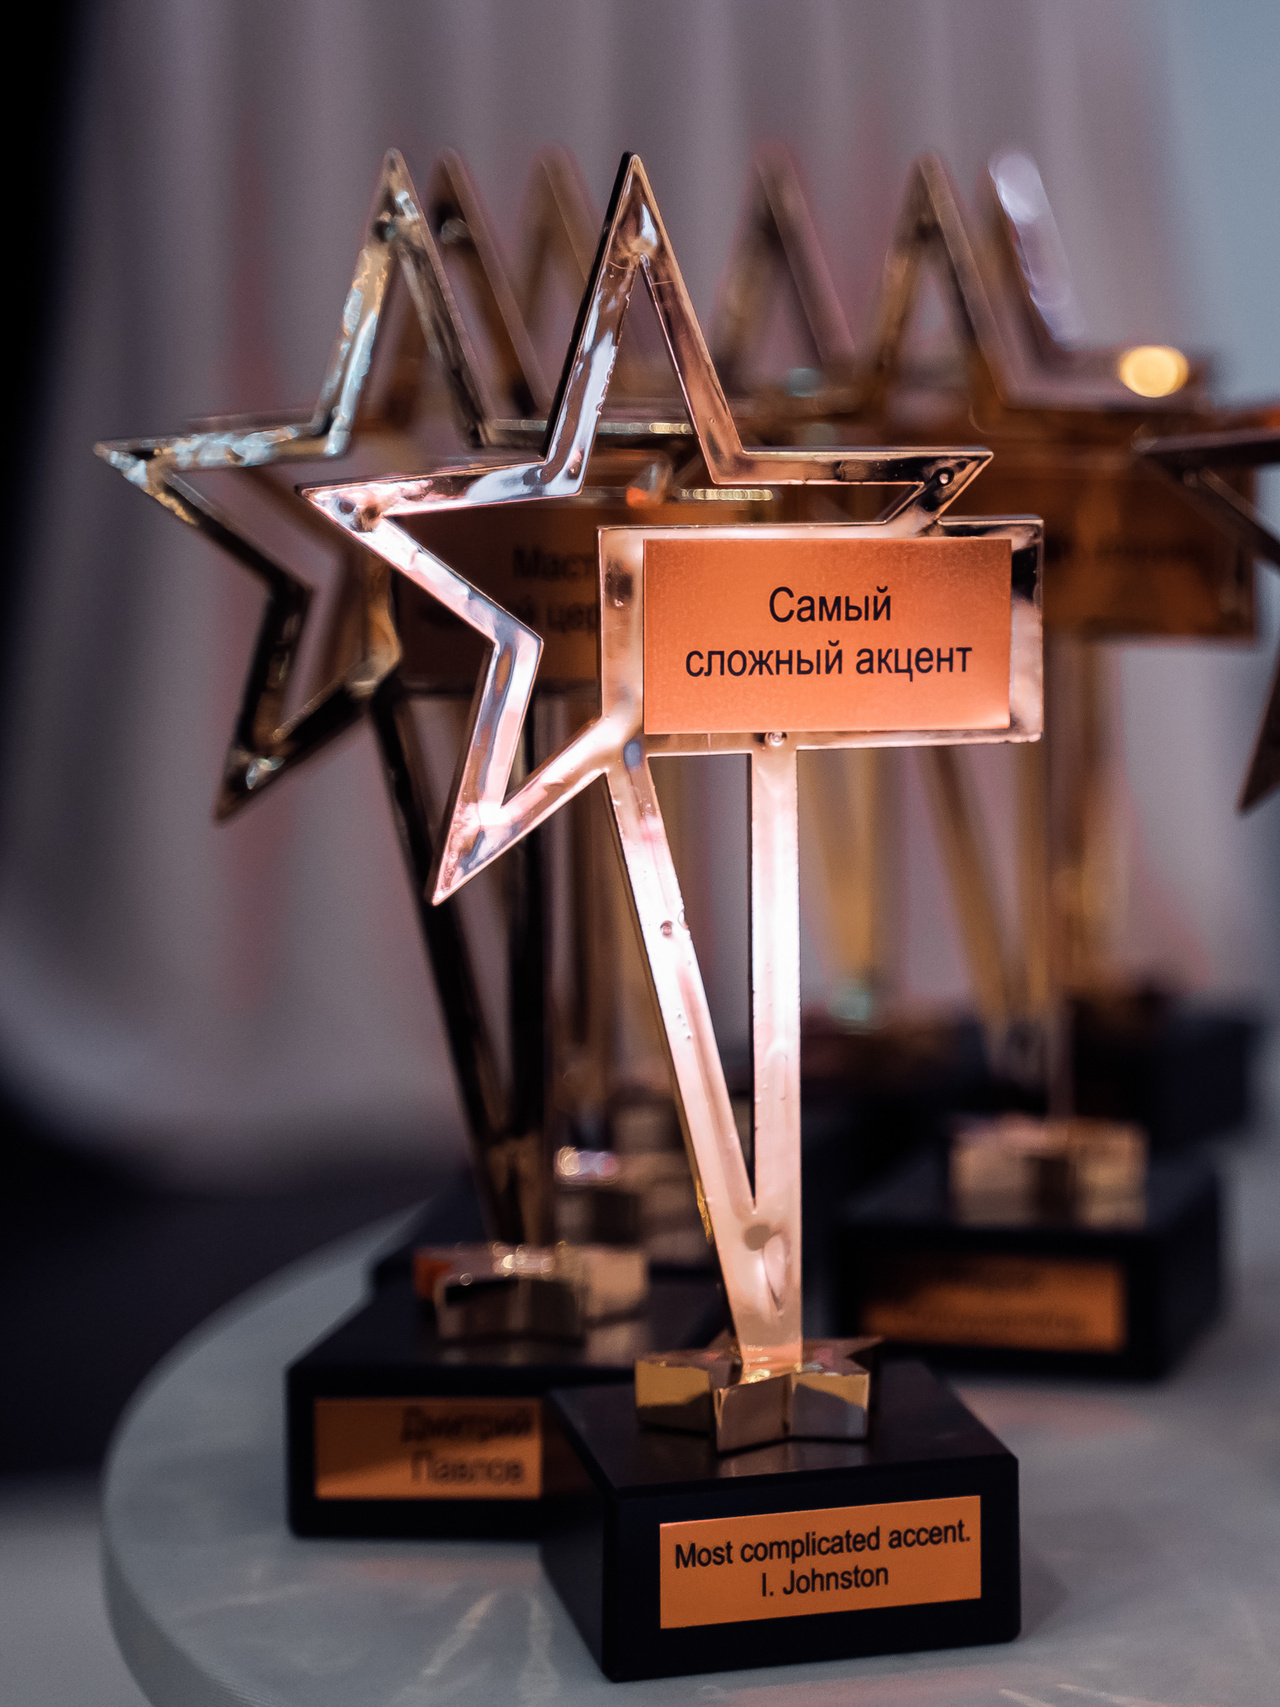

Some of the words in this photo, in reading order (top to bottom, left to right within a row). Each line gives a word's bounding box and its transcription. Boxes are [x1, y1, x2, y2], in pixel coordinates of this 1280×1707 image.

[512, 546, 598, 581] Маст
[768, 585, 892, 623] Самый
[685, 640, 843, 678] сложный
[855, 645, 973, 682] акцент
[401, 1405, 533, 1442] Дмитрий
[411, 1449, 525, 1485] Павлов
[674, 1540, 734, 1570] Most
[739, 1525, 881, 1565] complicated
[887, 1518, 972, 1551] accent.
[761, 1572, 774, 1597] I.
[782, 1565, 889, 1596] Johnston
